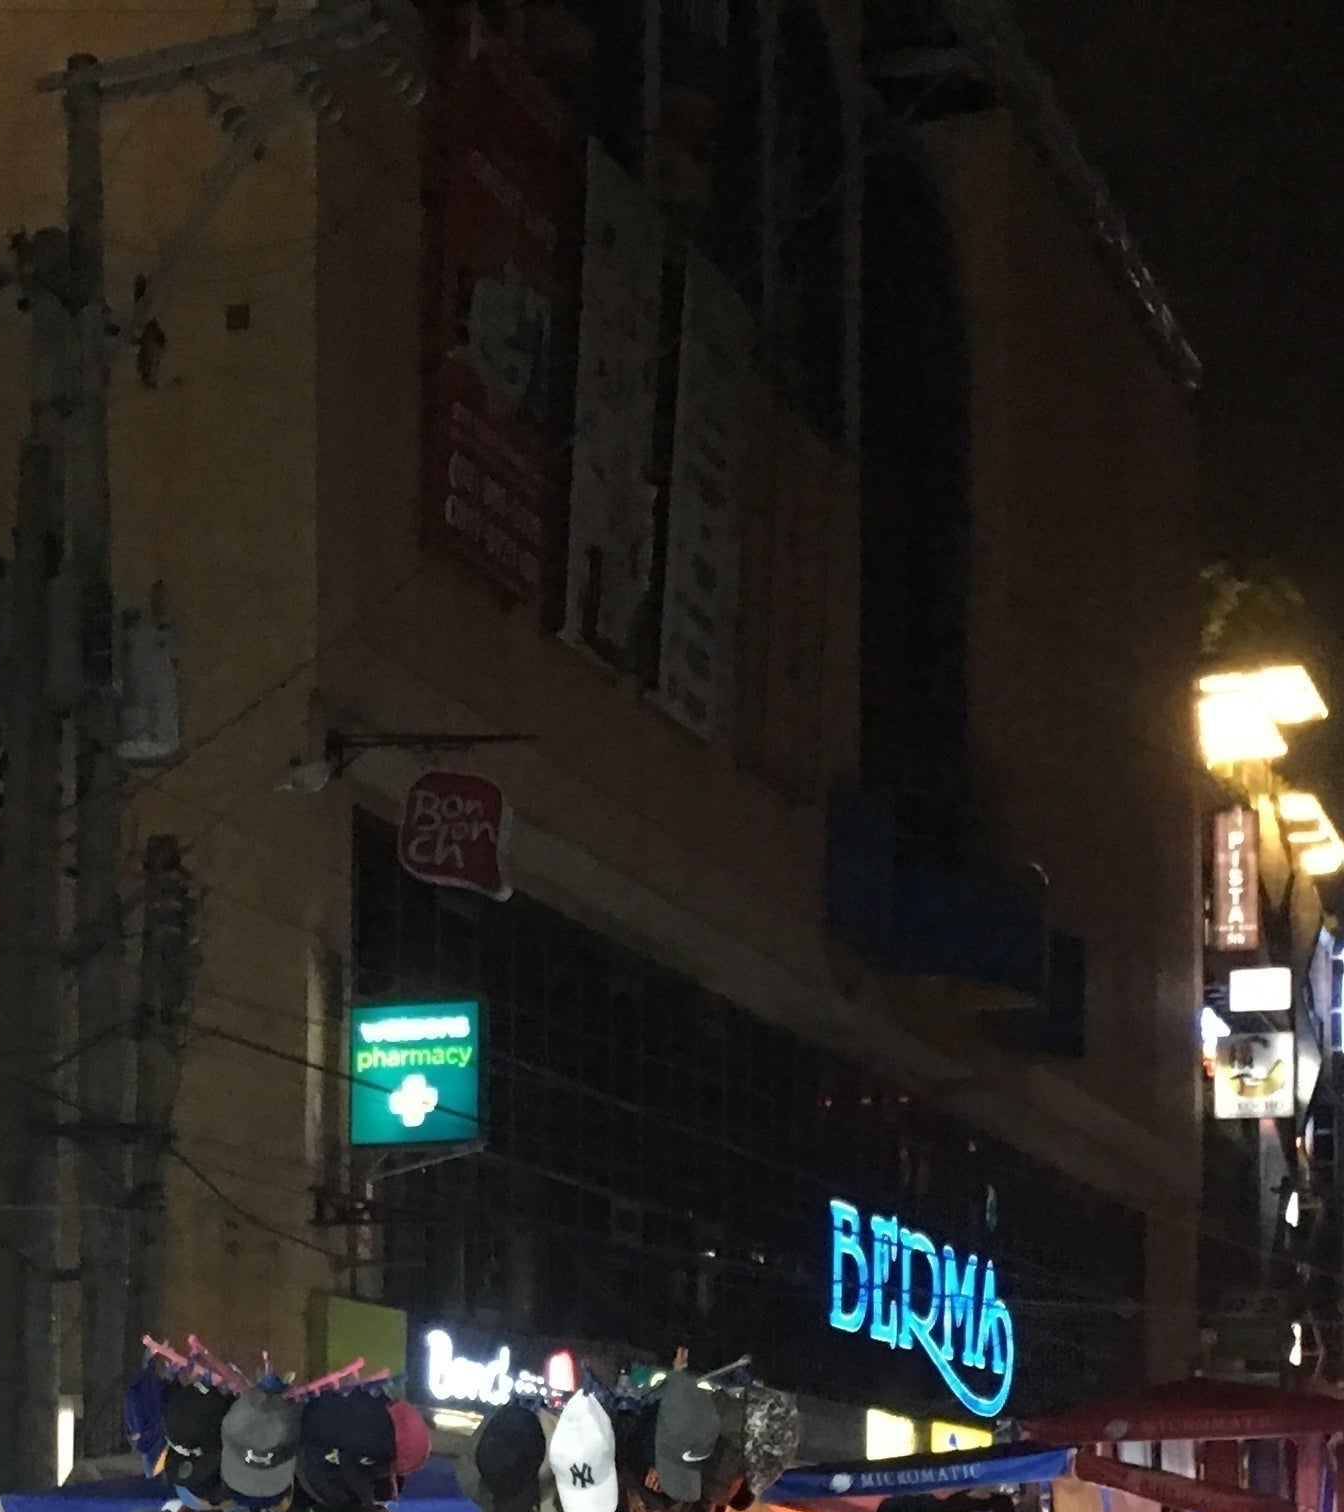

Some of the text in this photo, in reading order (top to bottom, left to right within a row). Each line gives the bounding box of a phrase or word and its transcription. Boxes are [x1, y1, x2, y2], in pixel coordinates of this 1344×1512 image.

[414, 789, 485, 831] Bon
[356, 1045, 473, 1072] pharmacy
[859, 1461, 983, 1489] MICROMATIC
